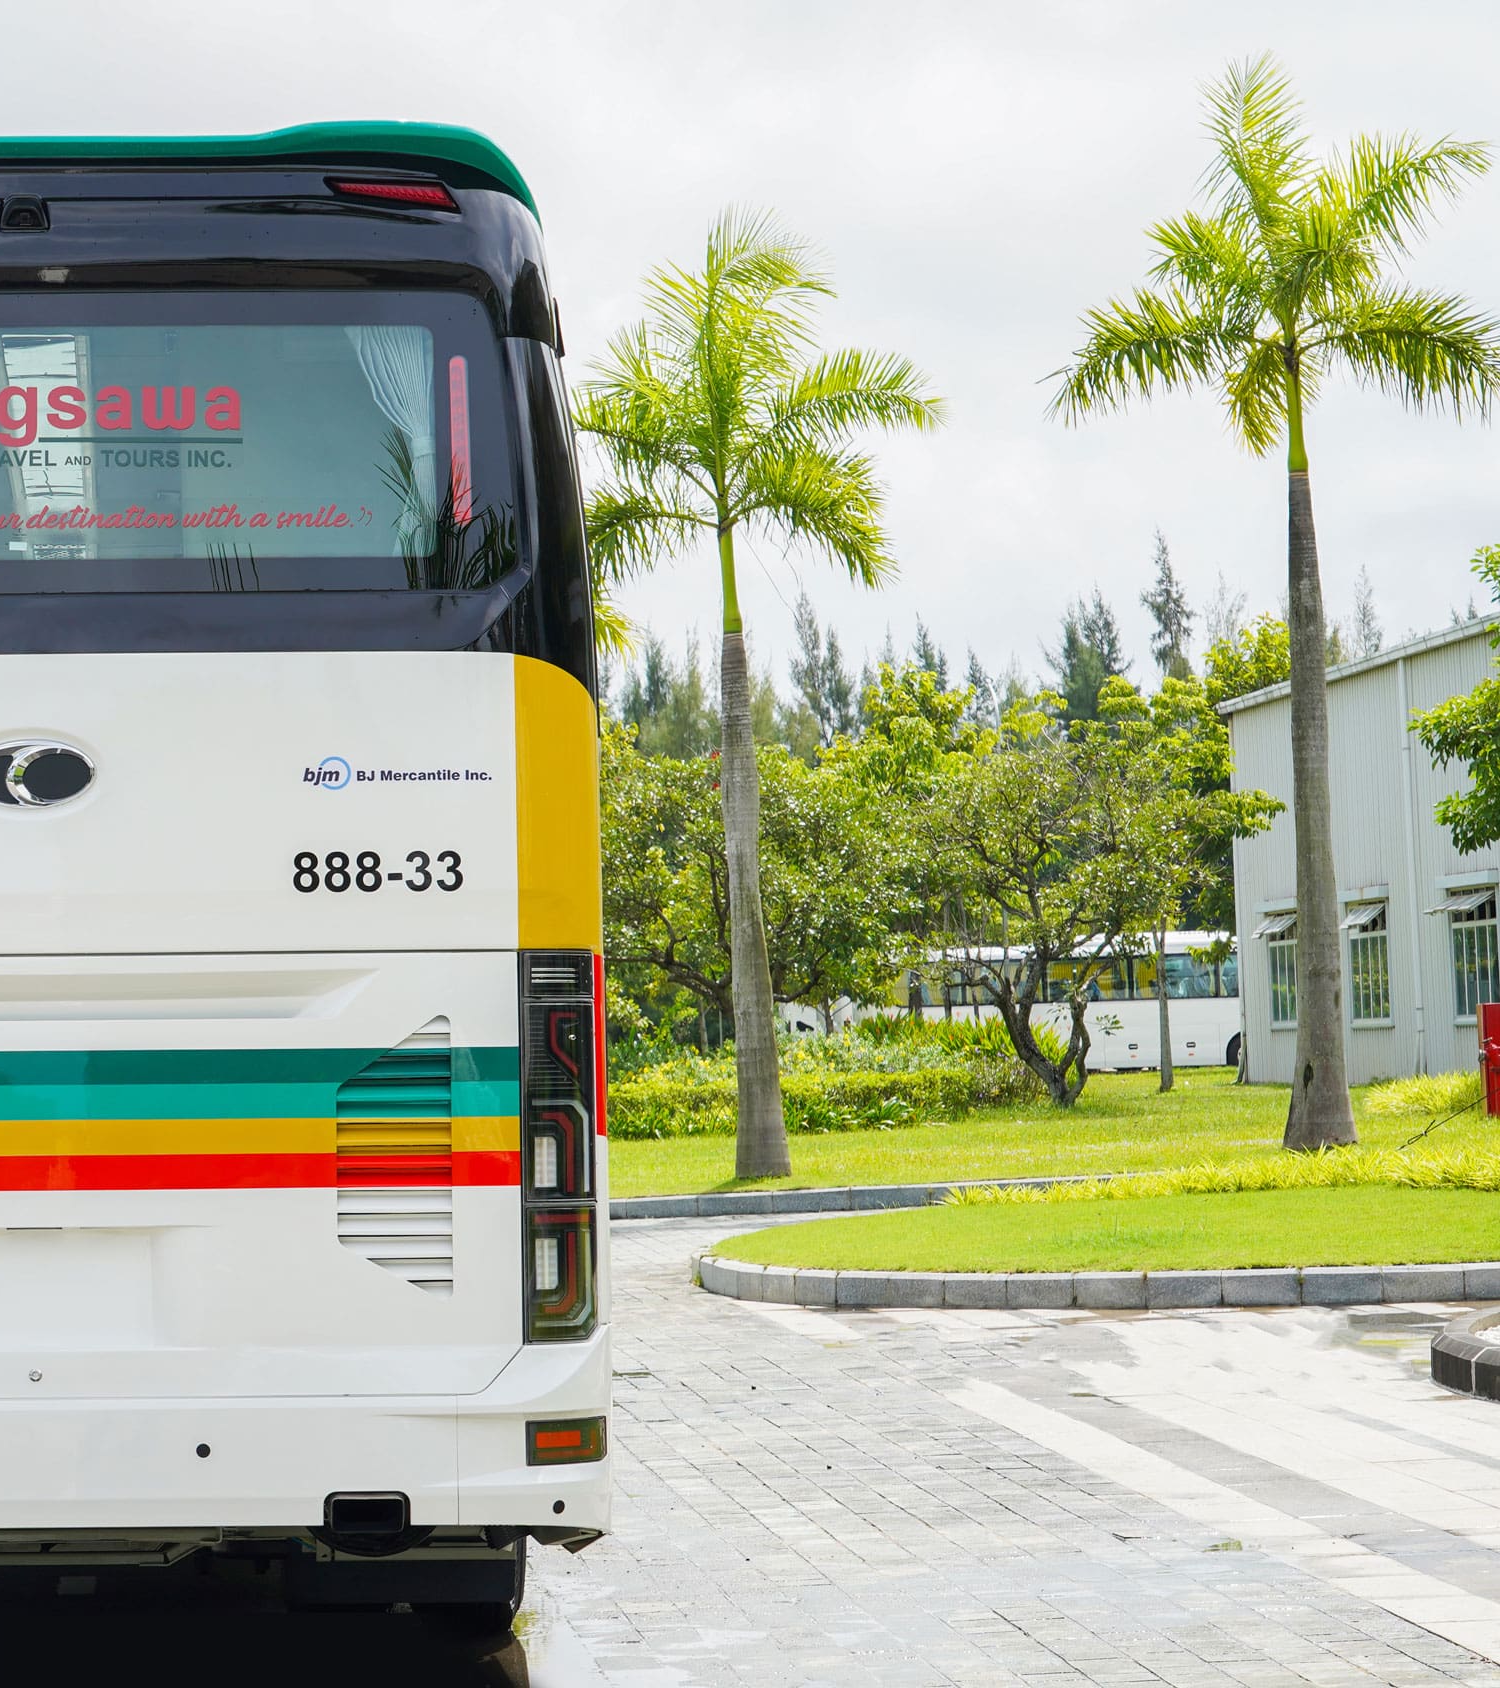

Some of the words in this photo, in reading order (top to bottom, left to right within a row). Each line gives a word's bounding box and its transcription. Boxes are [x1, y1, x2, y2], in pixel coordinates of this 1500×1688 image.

[65, 456, 92, 466] AND
[102, 450, 179, 468] TOURS
[187, 450, 232, 467] INC.
[25, 504, 179, 530] destination
[182, 504, 246, 528] with
[248, 511, 273, 528] a
[303, 767, 340, 785] bjm
[357, 771, 375, 781] BJ
[380, 769, 460, 781] Mercantile
[465, 769, 492, 780] Inc.
[293, 850, 464, 893] 888-33
